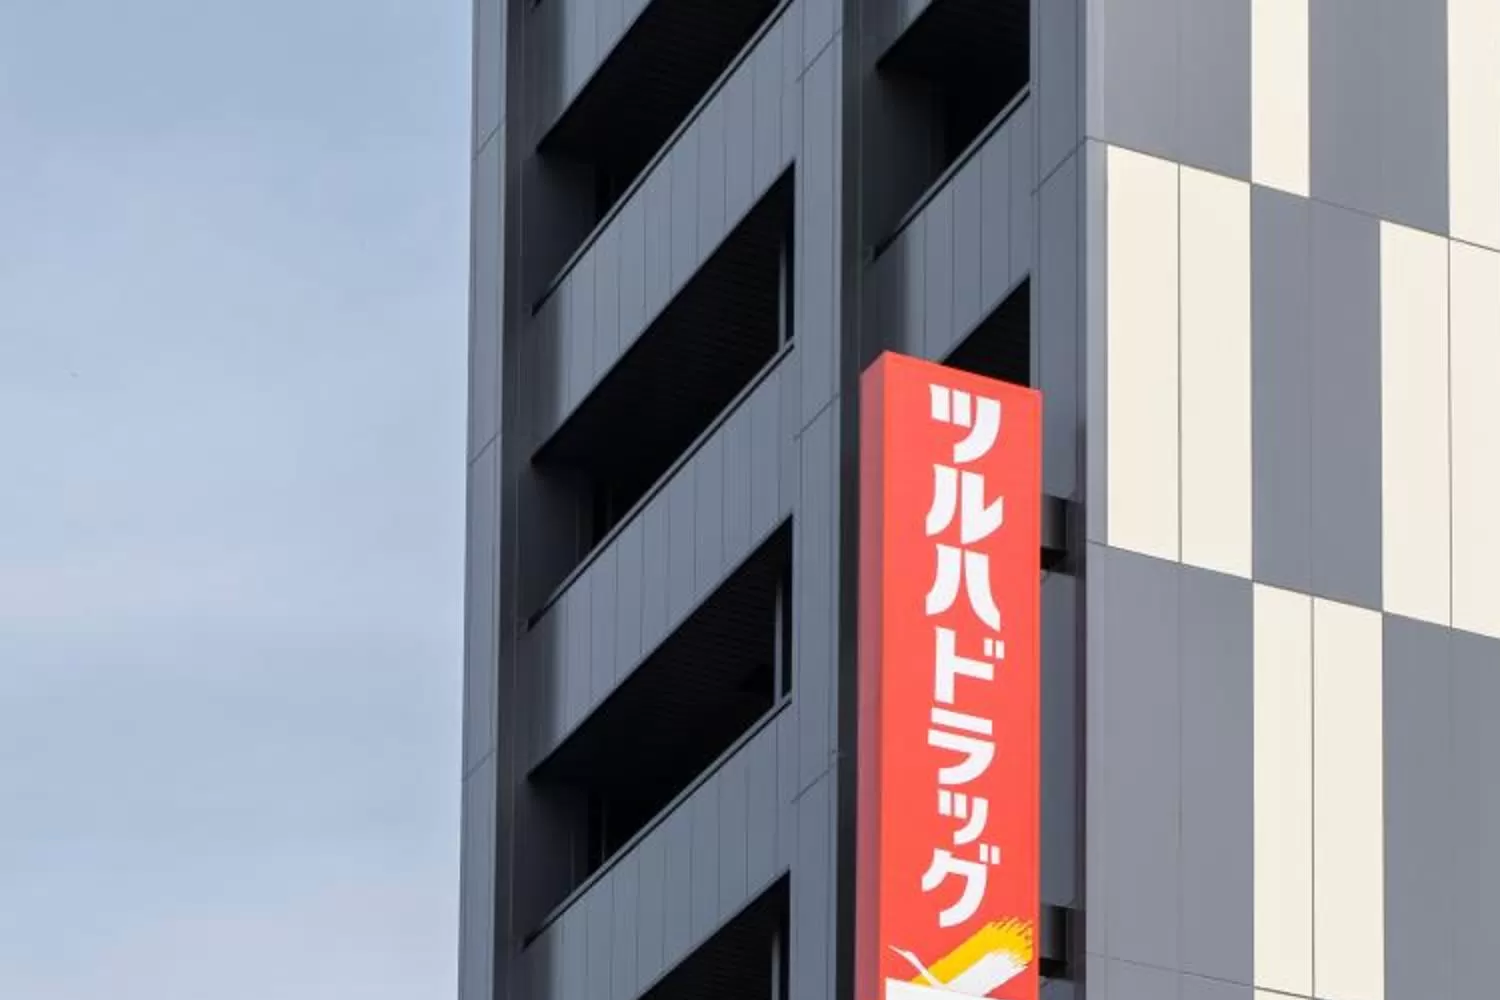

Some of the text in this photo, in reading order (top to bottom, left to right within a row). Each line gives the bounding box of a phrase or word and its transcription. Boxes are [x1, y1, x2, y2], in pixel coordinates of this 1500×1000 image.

[921, 384, 1004, 927] ツルハドラッグ
